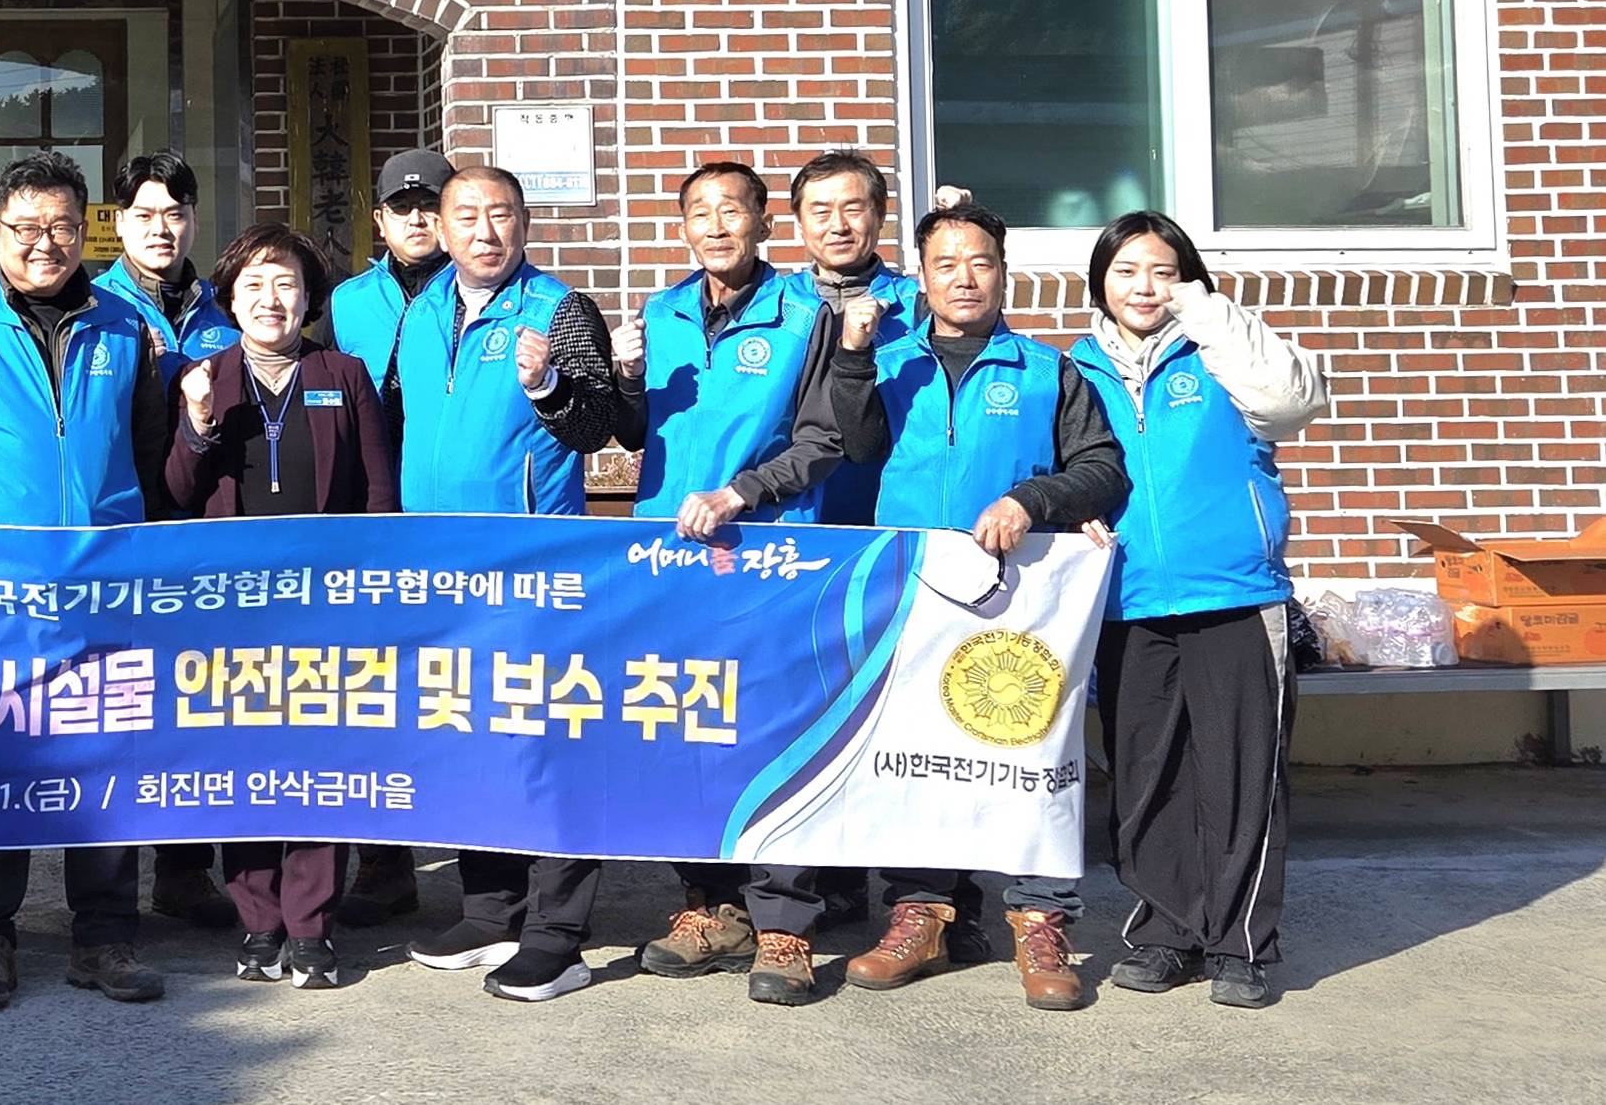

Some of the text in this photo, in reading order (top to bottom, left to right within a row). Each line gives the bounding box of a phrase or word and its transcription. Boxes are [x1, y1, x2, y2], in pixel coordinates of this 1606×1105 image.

[311, 114, 350, 277] 大韓老人
[741, 537, 831, 580] 장흥
[324, 568, 503, 606] 업무협약에
[513, 572, 586, 609] 따른
[174, 645, 398, 729] 안전점검
[417, 647, 473, 733] 및
[489, 651, 603, 739] 보수
[622, 653, 739, 744] 추진
[101, 775, 116, 810] /
[135, 770, 234, 808] 회진면
[246, 770, 416, 810] 안삭금마을
